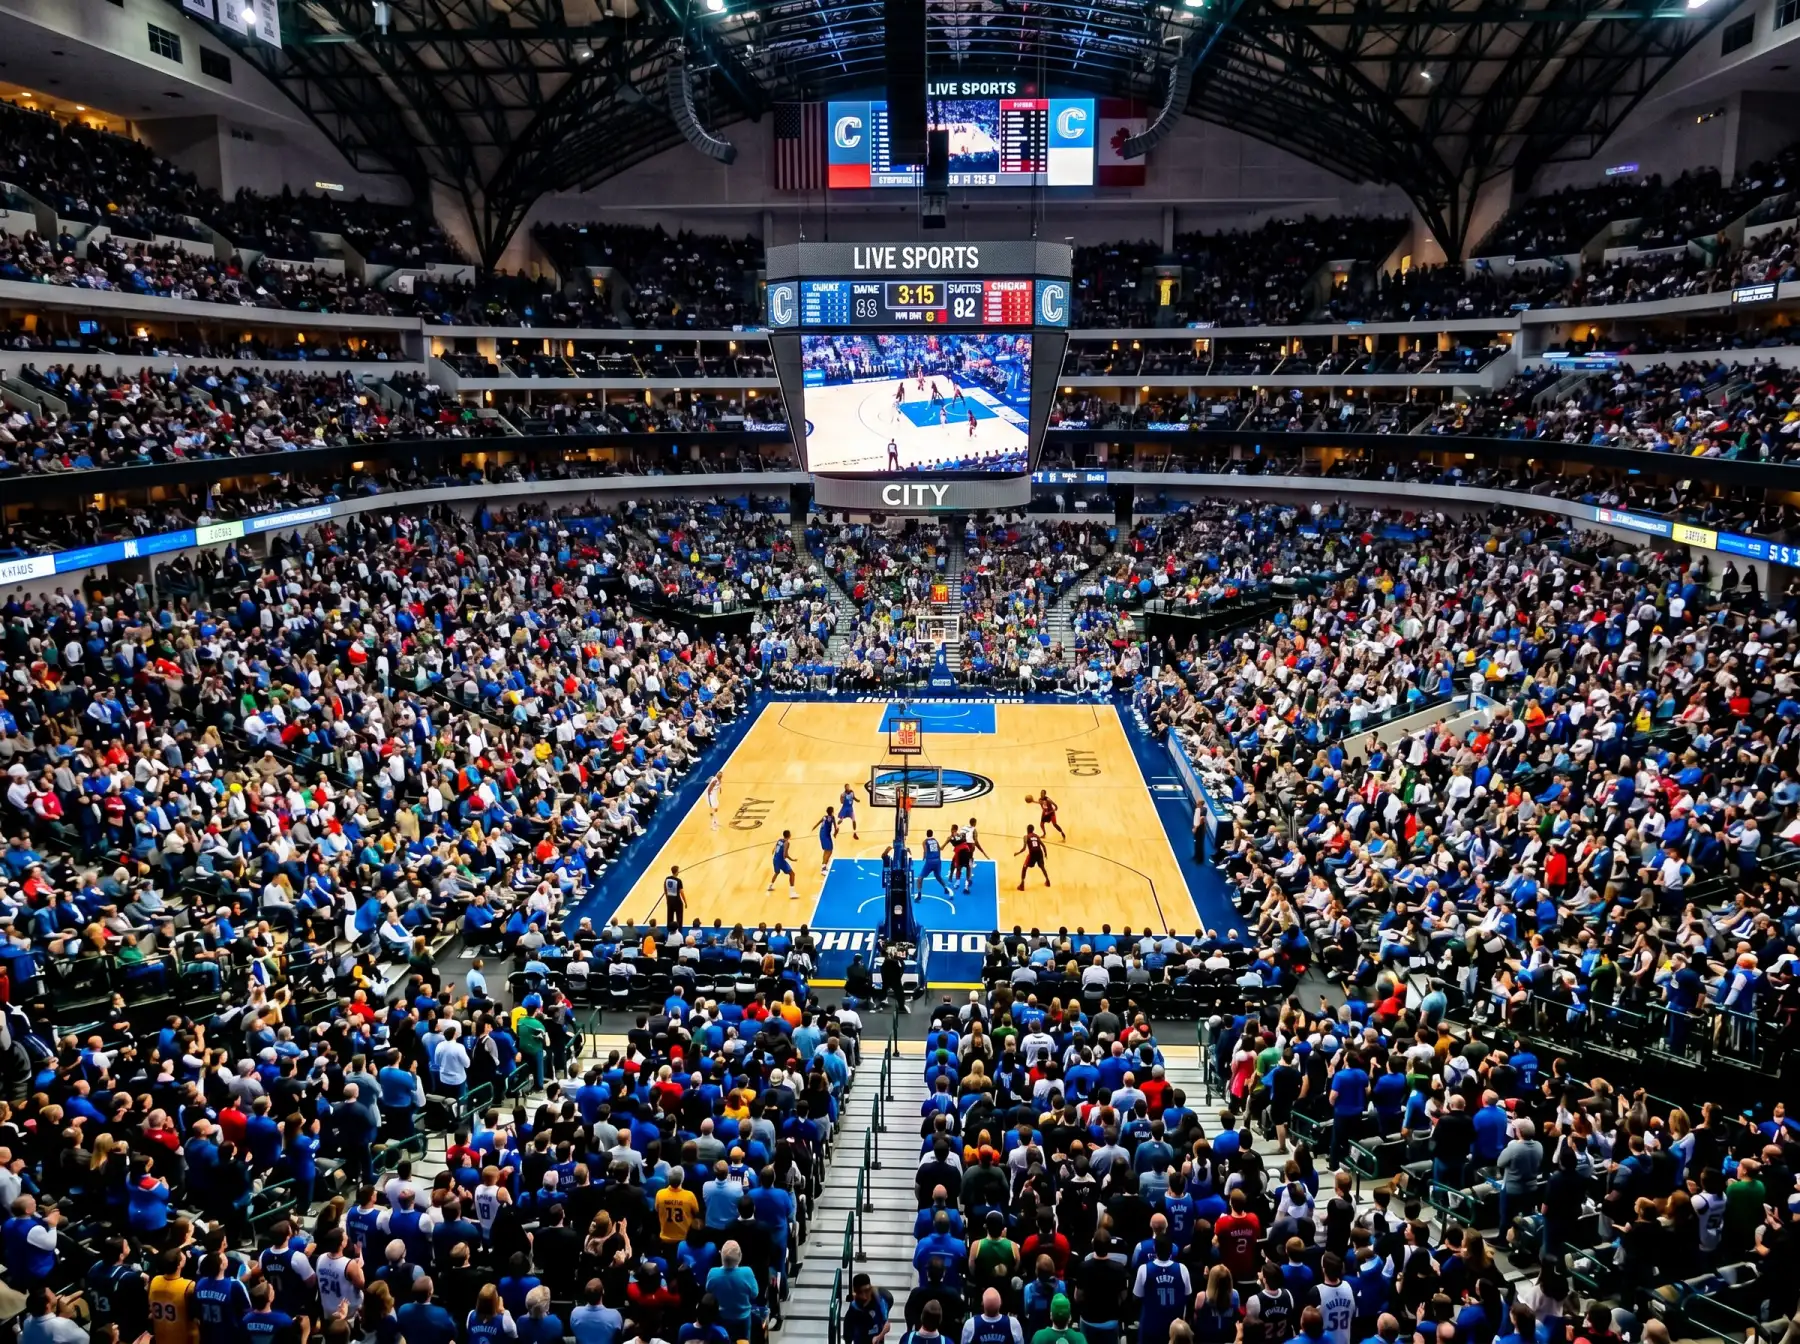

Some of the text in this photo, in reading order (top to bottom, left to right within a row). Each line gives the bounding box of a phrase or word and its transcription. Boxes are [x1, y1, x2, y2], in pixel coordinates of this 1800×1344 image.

[928, 82, 1016, 95] LIVE SPORTS
[854, 247, 979, 269] LIVE SPORTS
[898, 285, 935, 304] 3:15
[953, 297, 976, 318] 82
[882, 485, 950, 508] CITY
